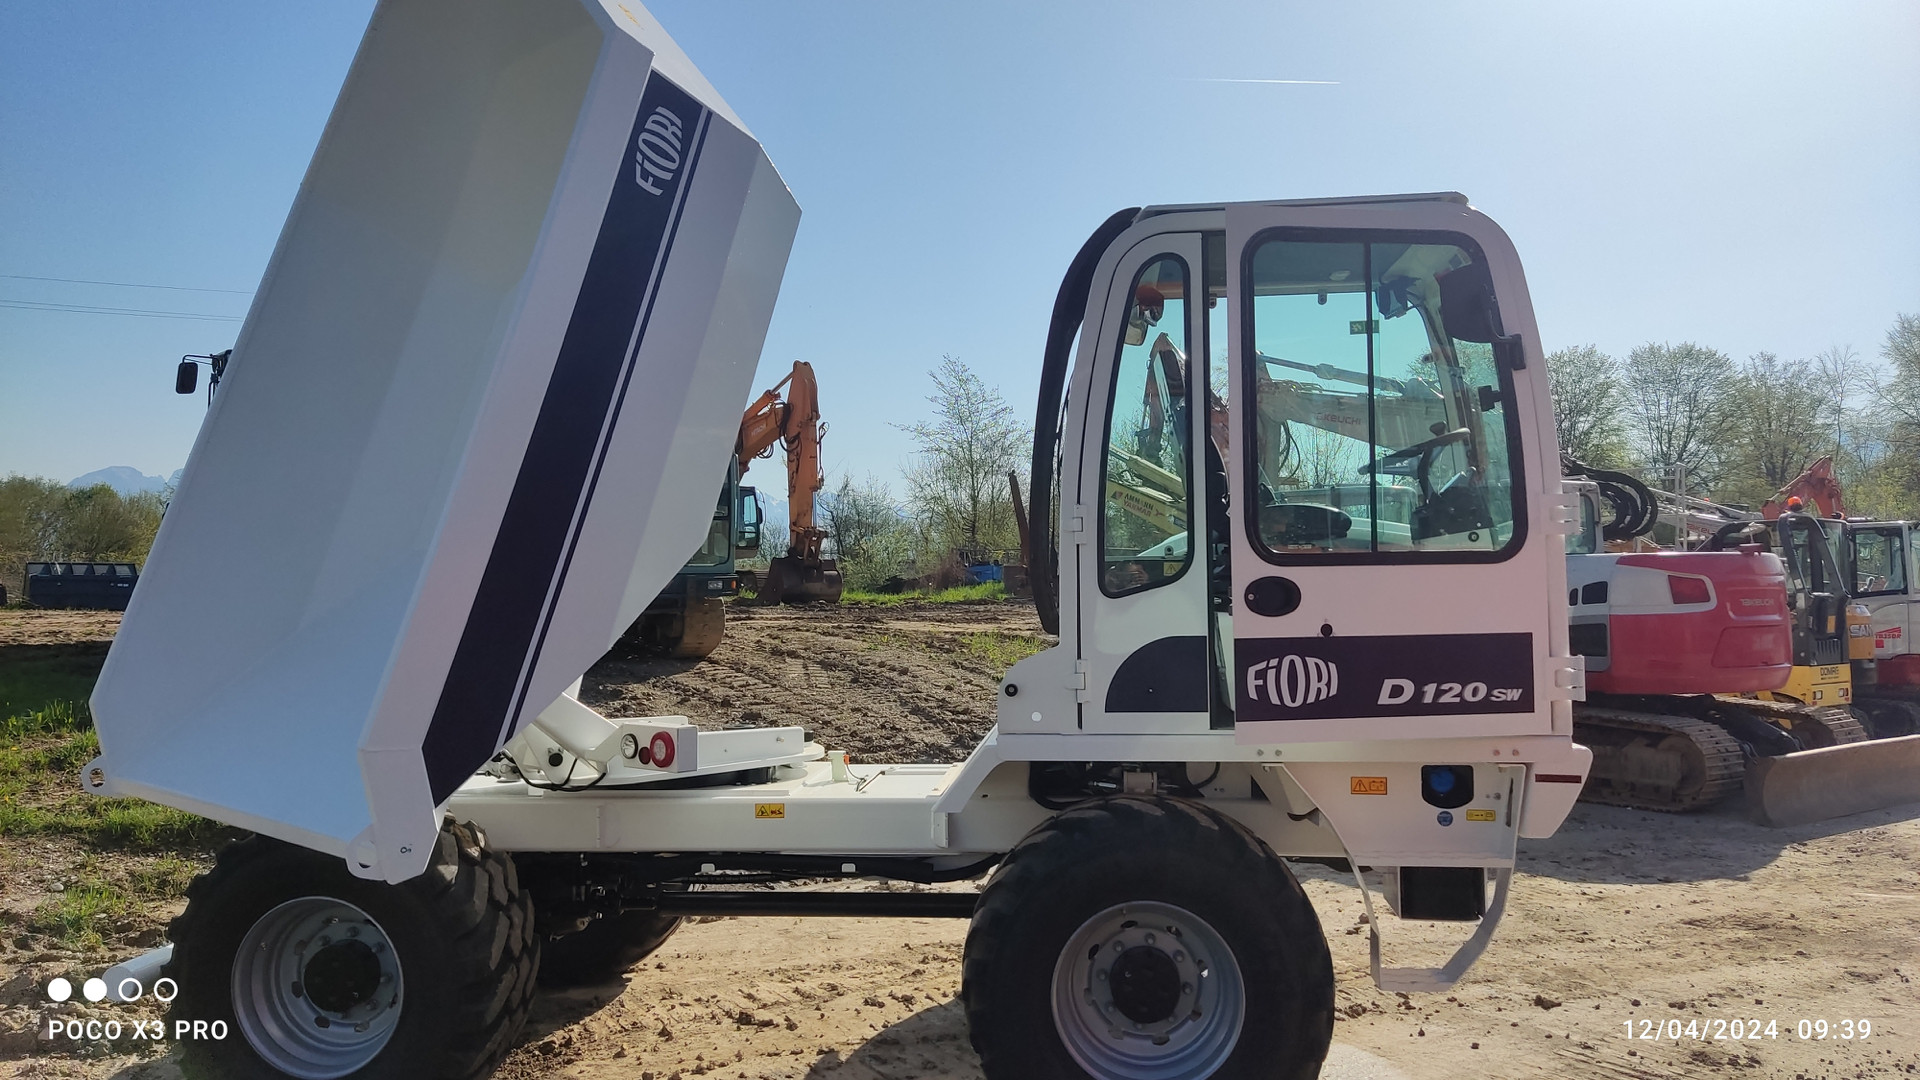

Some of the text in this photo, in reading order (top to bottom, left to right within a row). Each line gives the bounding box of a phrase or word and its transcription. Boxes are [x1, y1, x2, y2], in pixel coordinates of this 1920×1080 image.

[635, 105, 683, 196] FiORI
[1246, 654, 1338, 708] FiORI
[1377, 678, 1523, 705] D 120 SW
